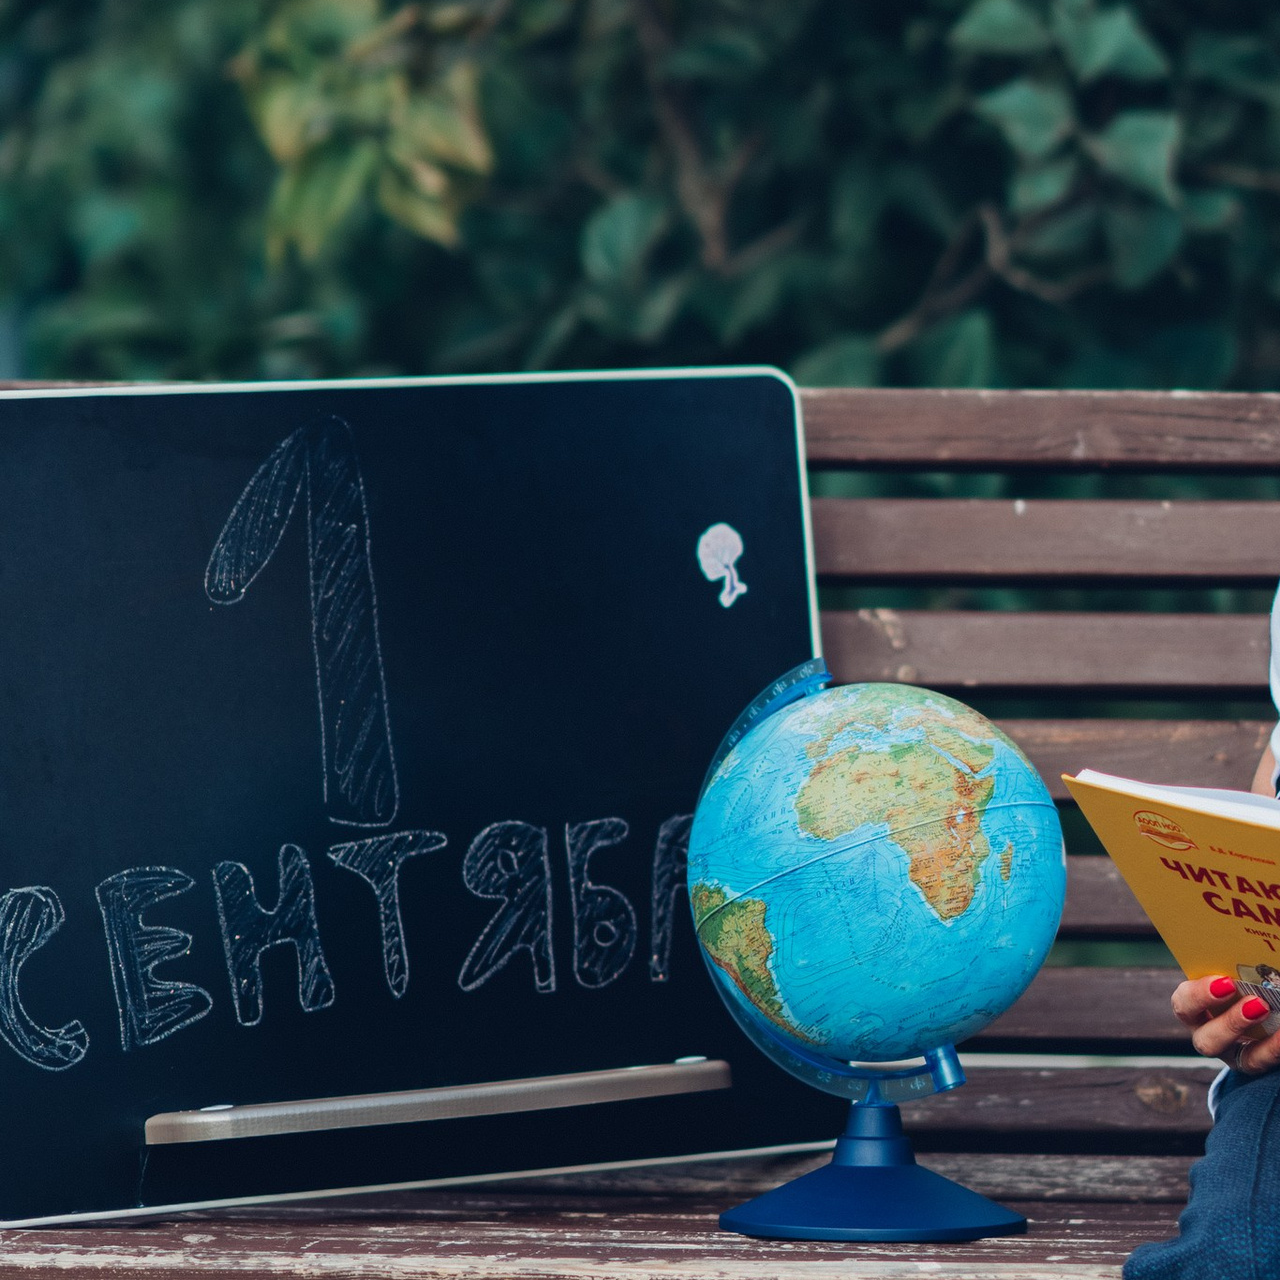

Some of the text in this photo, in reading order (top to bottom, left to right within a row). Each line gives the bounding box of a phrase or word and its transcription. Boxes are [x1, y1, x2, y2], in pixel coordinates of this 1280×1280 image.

[204, 415, 400, 828] 1
[0, 813, 694, 1071] СЕНТЯБР
[1244, 926, 1280, 941] КНИГА
[1264, 939, 1277, 952] 1
